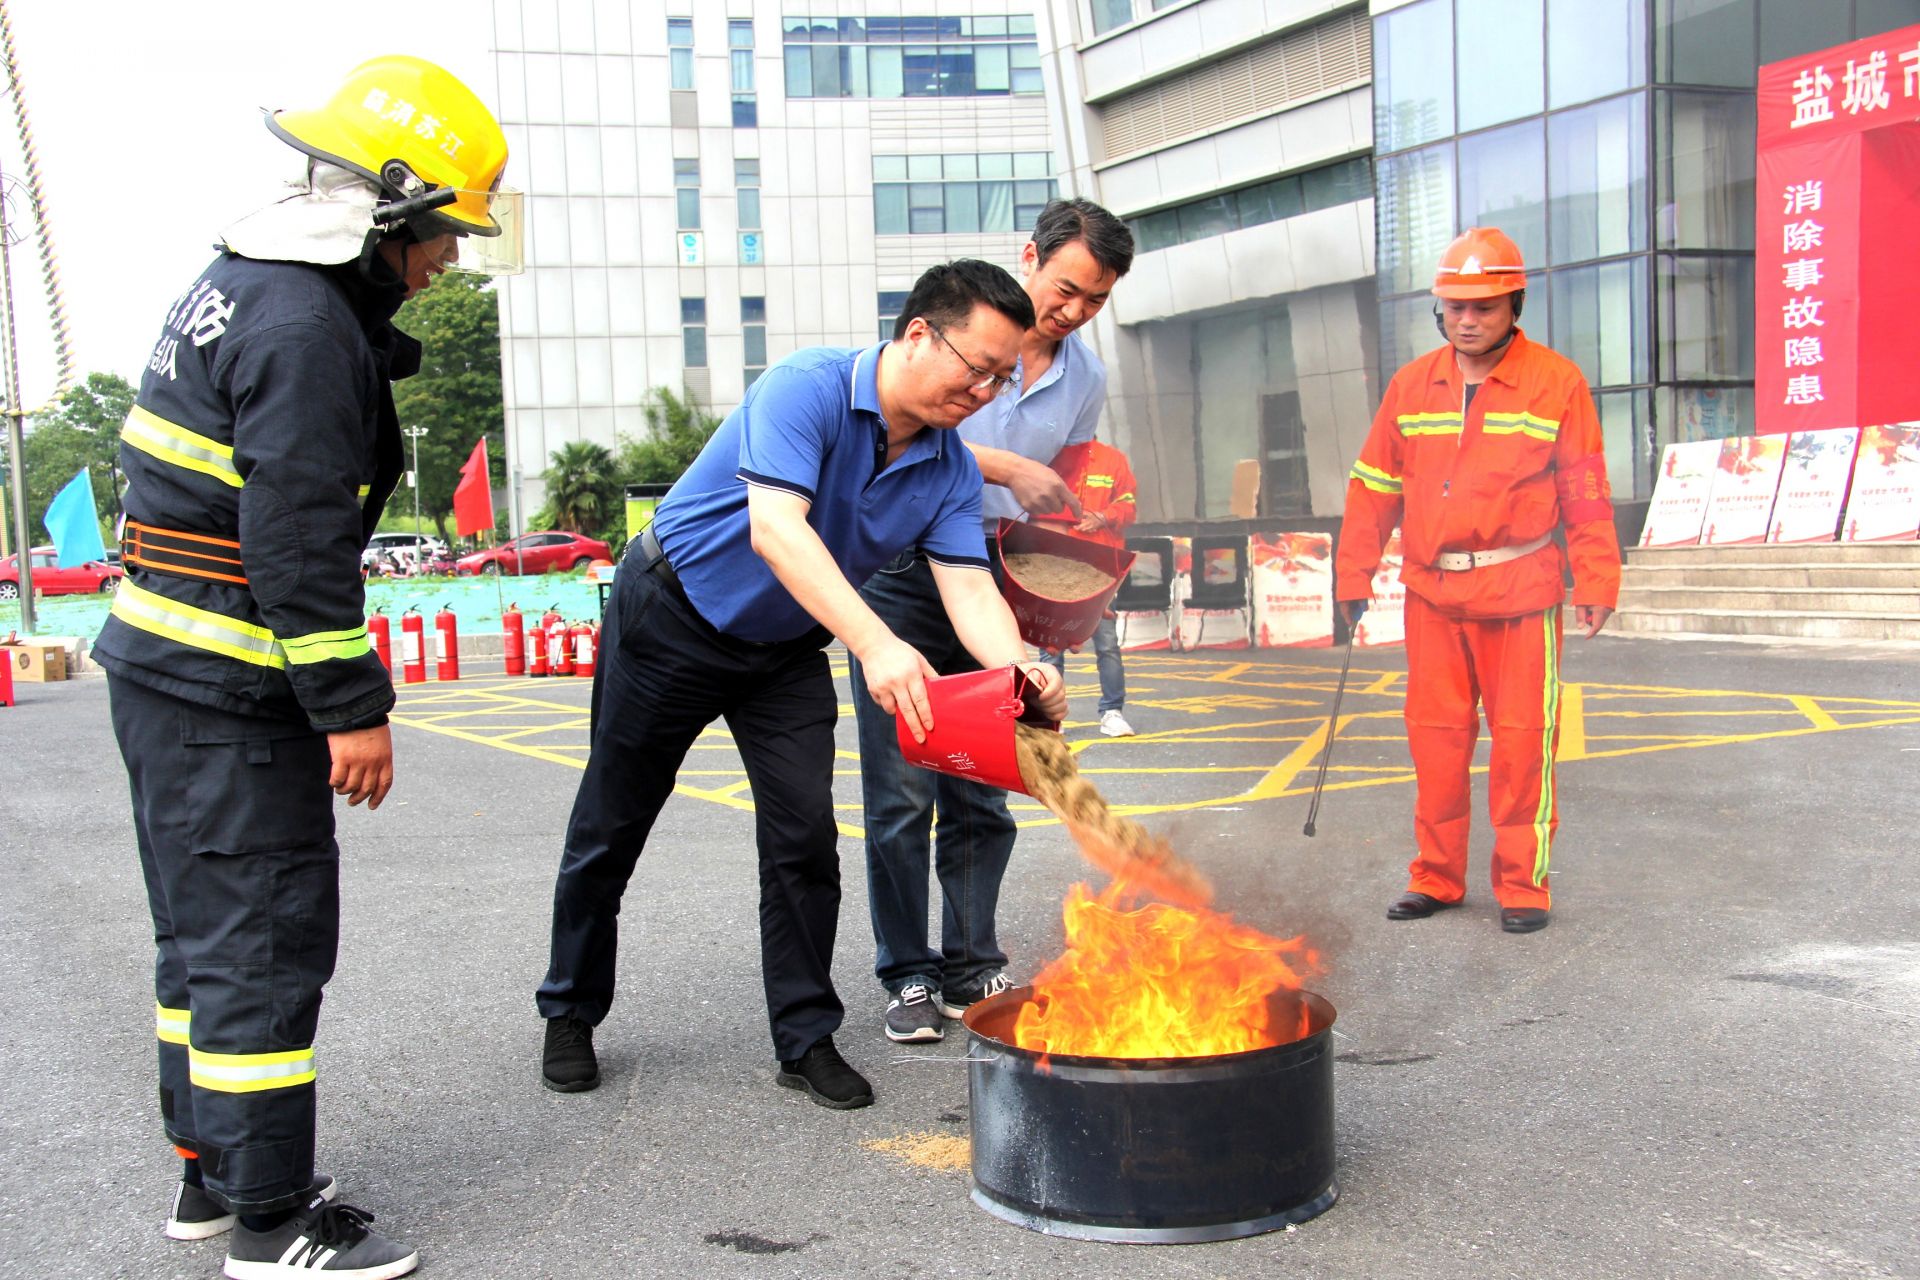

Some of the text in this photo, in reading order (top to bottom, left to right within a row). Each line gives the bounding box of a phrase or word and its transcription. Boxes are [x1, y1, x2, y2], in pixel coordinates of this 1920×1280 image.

[1782, 180, 1824, 405] 消除事故隐患
